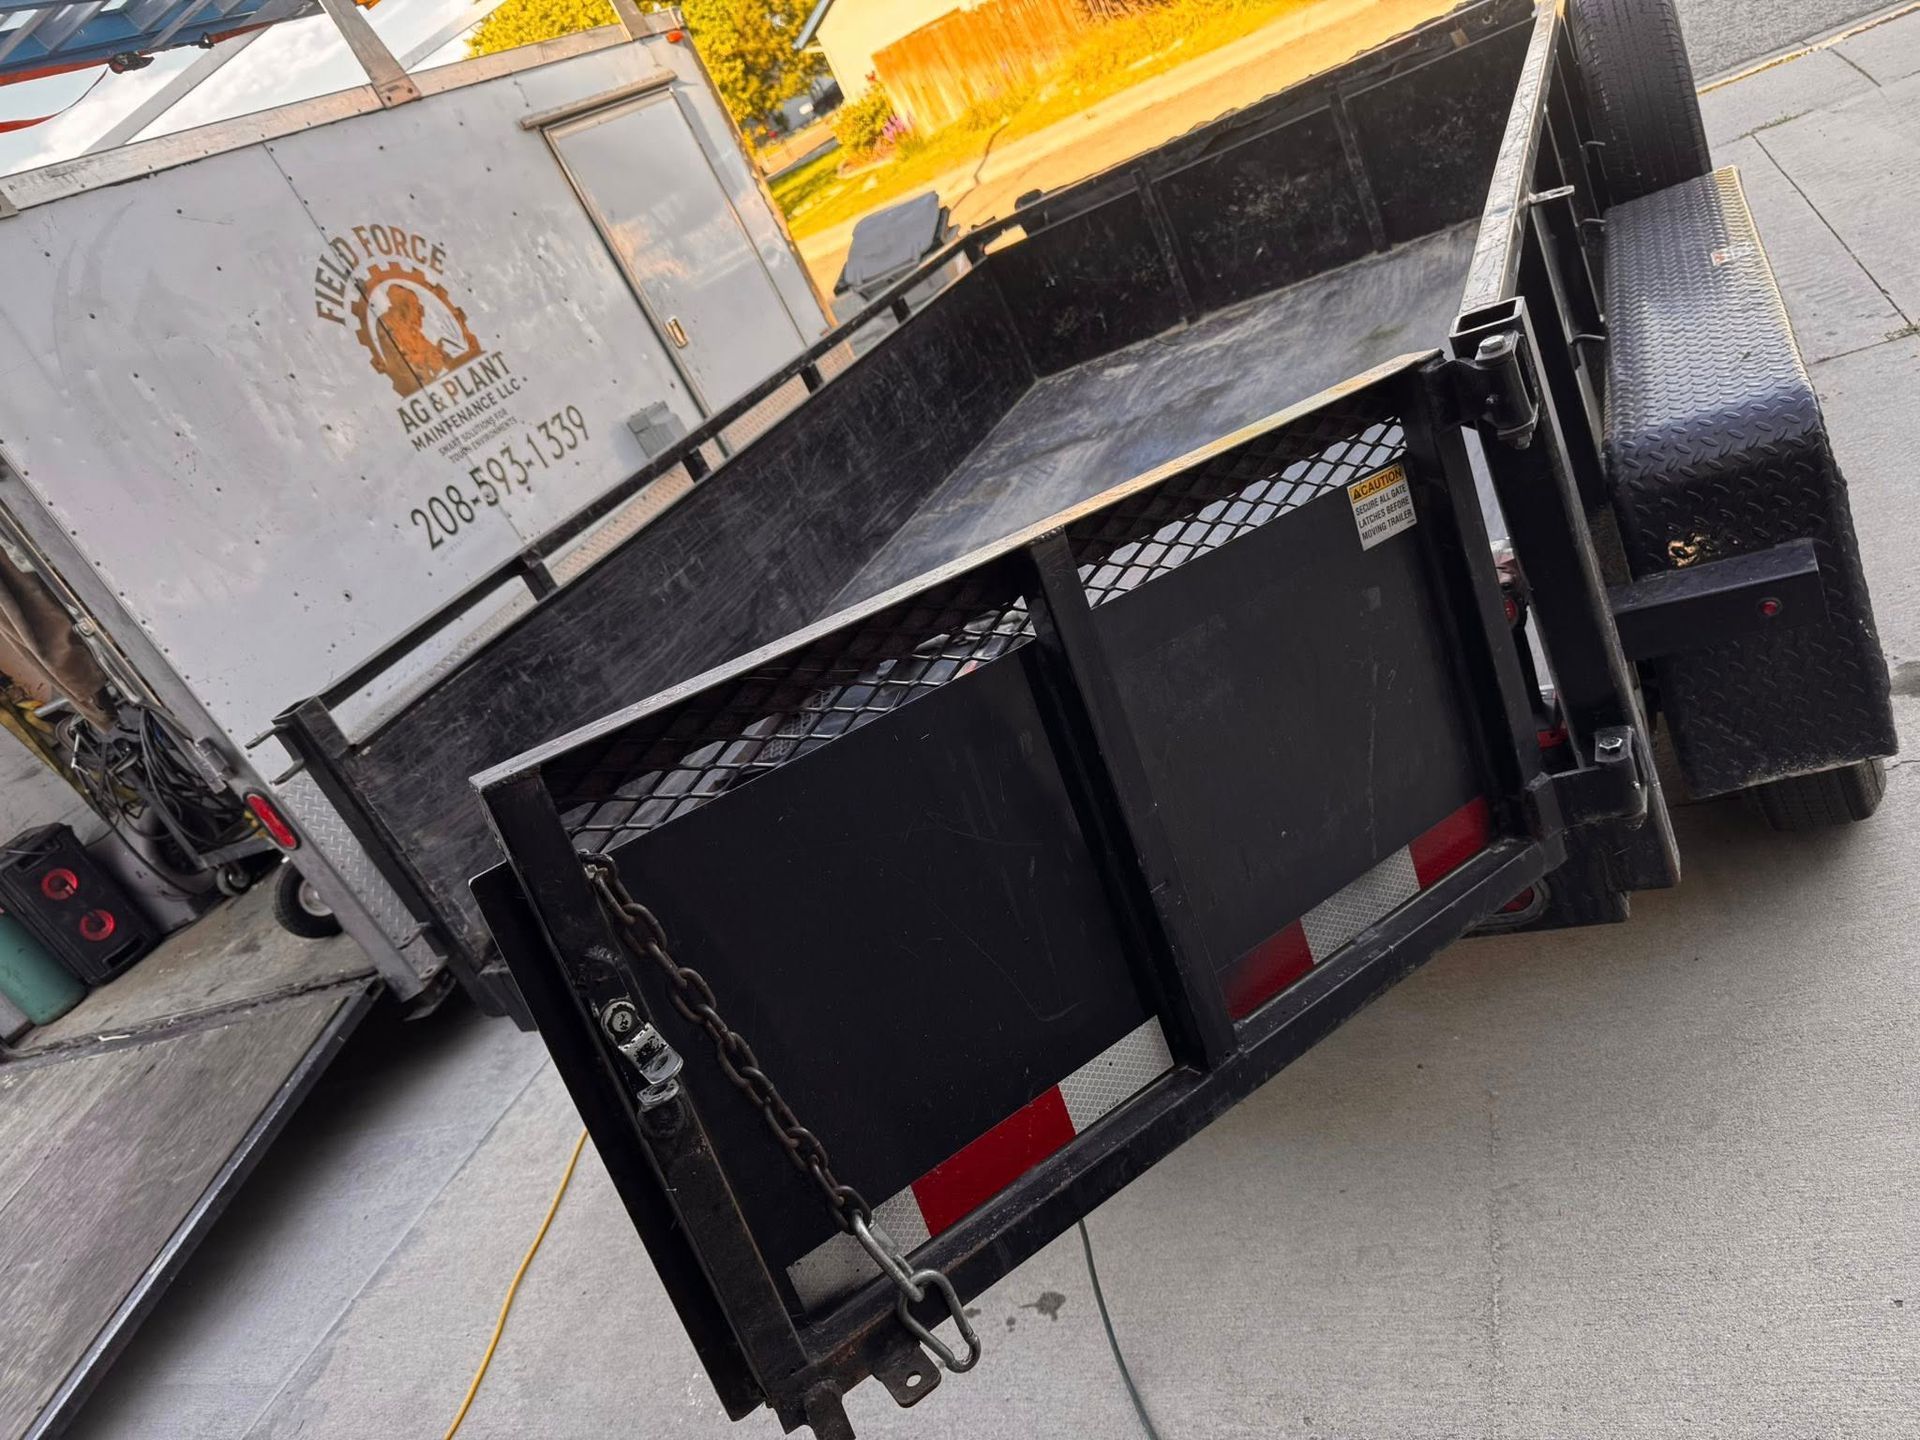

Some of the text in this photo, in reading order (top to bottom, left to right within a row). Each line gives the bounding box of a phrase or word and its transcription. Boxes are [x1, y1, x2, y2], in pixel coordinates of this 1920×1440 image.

[314, 223, 447, 327] FIELD FORCE
[397, 351, 511, 434] AG & PLANT
[411, 378, 521, 452] MAINTENANCE LLC
[410, 404, 590, 550] 208-593-1339
[1355, 483, 1408, 516] SECURE ALL GATE
[1360, 468, 1402, 496] CAUTION
[1358, 495, 1410, 529] LATCHES BEFORE
[1361, 508, 1414, 541] MOVING TRAILER
